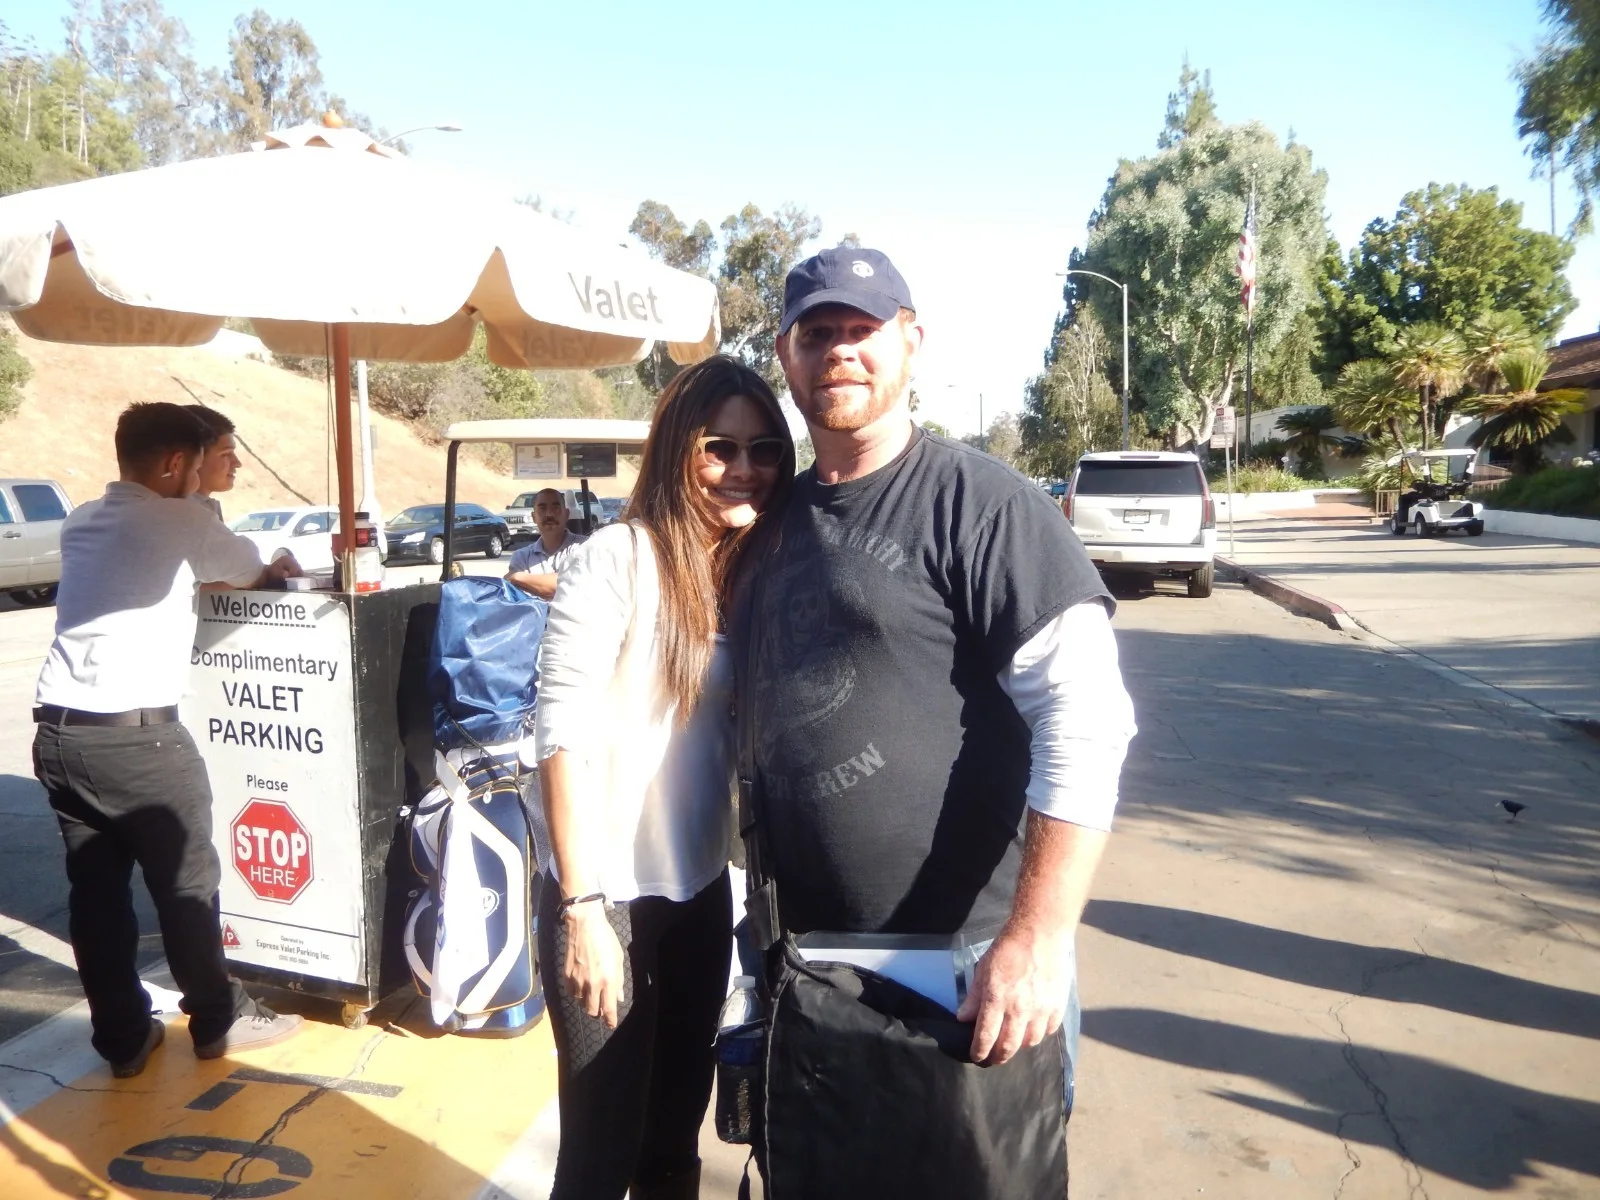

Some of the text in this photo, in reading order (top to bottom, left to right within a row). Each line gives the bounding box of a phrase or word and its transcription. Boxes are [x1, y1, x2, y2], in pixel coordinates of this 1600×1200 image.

[568, 272, 663, 324] Valet
[210, 594, 306, 621] Welcome
[222, 680, 303, 713] VALET
[209, 717, 324, 754] PARKING
[246, 774, 289, 792] Please
[236, 824, 307, 869] STOP
[250, 864, 296, 888] HERE
[256, 939, 279, 951] Express
[281, 944, 295, 954] Valet
[296, 947, 319, 960] Parking
